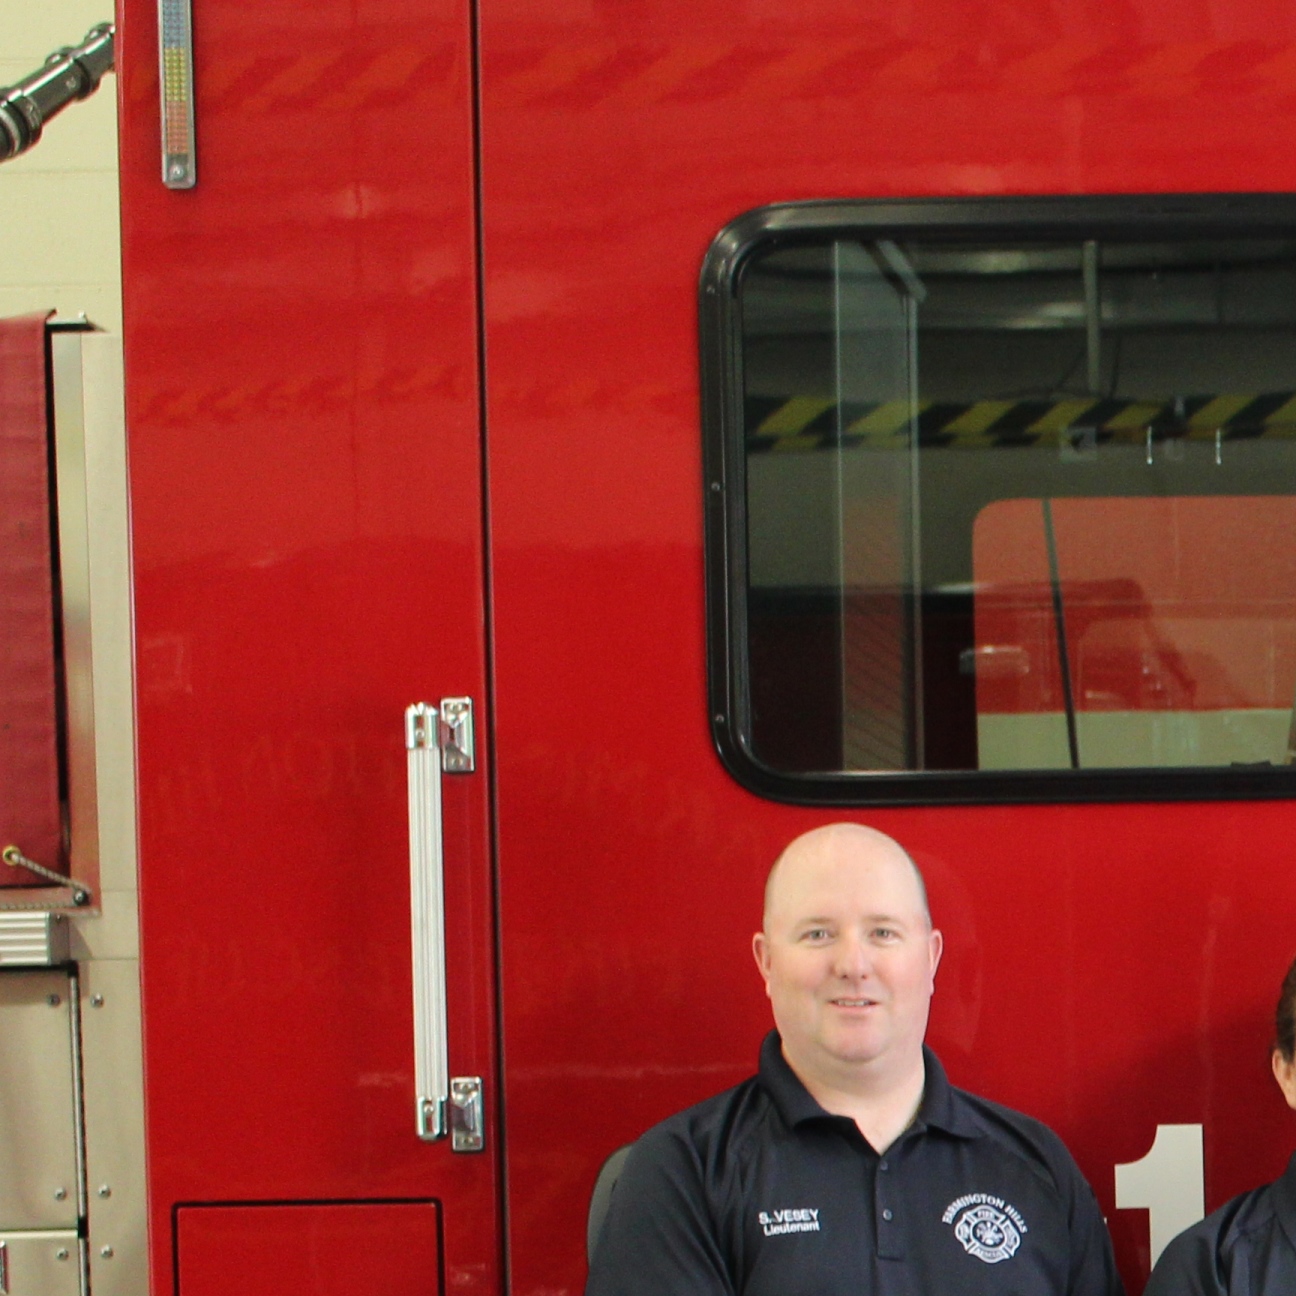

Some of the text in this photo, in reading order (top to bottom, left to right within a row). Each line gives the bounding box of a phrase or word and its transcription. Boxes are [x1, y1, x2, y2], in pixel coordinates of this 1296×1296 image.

[1115, 1123, 1204, 1272] 1
[763, 1221, 820, 1237] Lieutenant
[1004, 1205, 1028, 1233] HILLS
